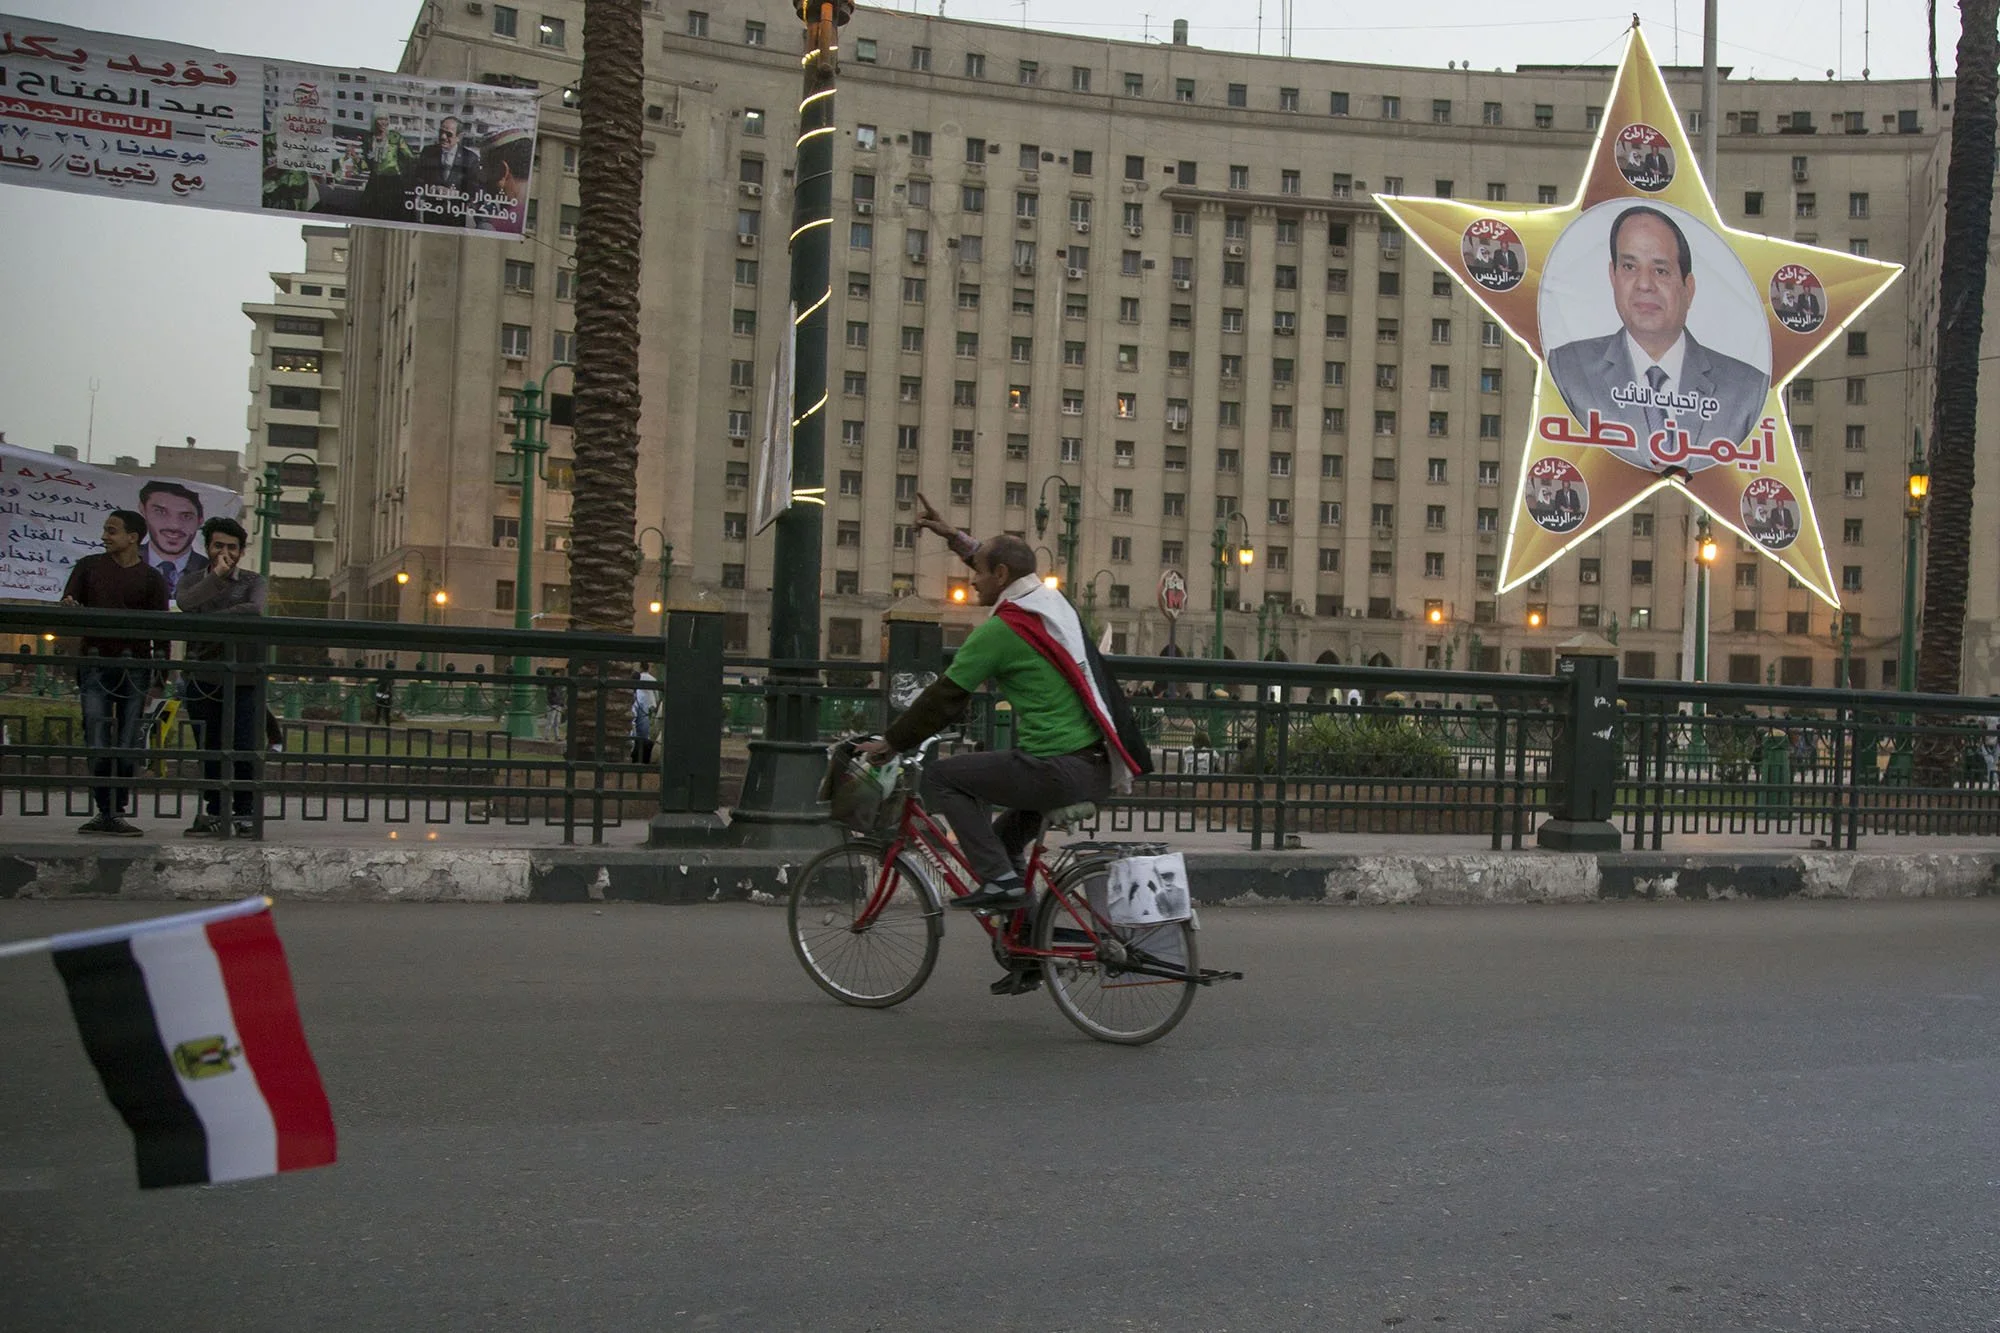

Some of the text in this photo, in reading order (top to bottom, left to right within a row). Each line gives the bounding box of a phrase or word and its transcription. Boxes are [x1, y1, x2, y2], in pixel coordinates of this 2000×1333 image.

[16, 71, 150, 109] الفتاح
[159, 98, 234, 119] عبد
[1623, 126, 1655, 144] مواطن
[116, 139, 206, 164] موعدنا
[172, 173, 204, 193] مع
[1628, 171, 1660, 187] الرئيس
[404, 198, 444, 215] معاه
[473, 188, 518, 207] مشوار
[1471, 221, 1505, 239] مواطن
[1475, 268, 1508, 285] الرئيس
[1778, 267, 1807, 284] مواطن
[1782, 312, 1811, 327] الرئيس
[1613, 383, 1718, 418] مع تحيات النائب
[1539, 411, 1776, 471] أيمن طه
[1533, 459, 1567, 479] مواطن
[1749, 480, 1780, 498] مواطن
[29, 509, 87, 525] السيد
[1537, 510, 1570, 527] الرئيس
[8, 524, 65, 543] الفتاح
[1755, 527, 1785, 544] الرئيس
